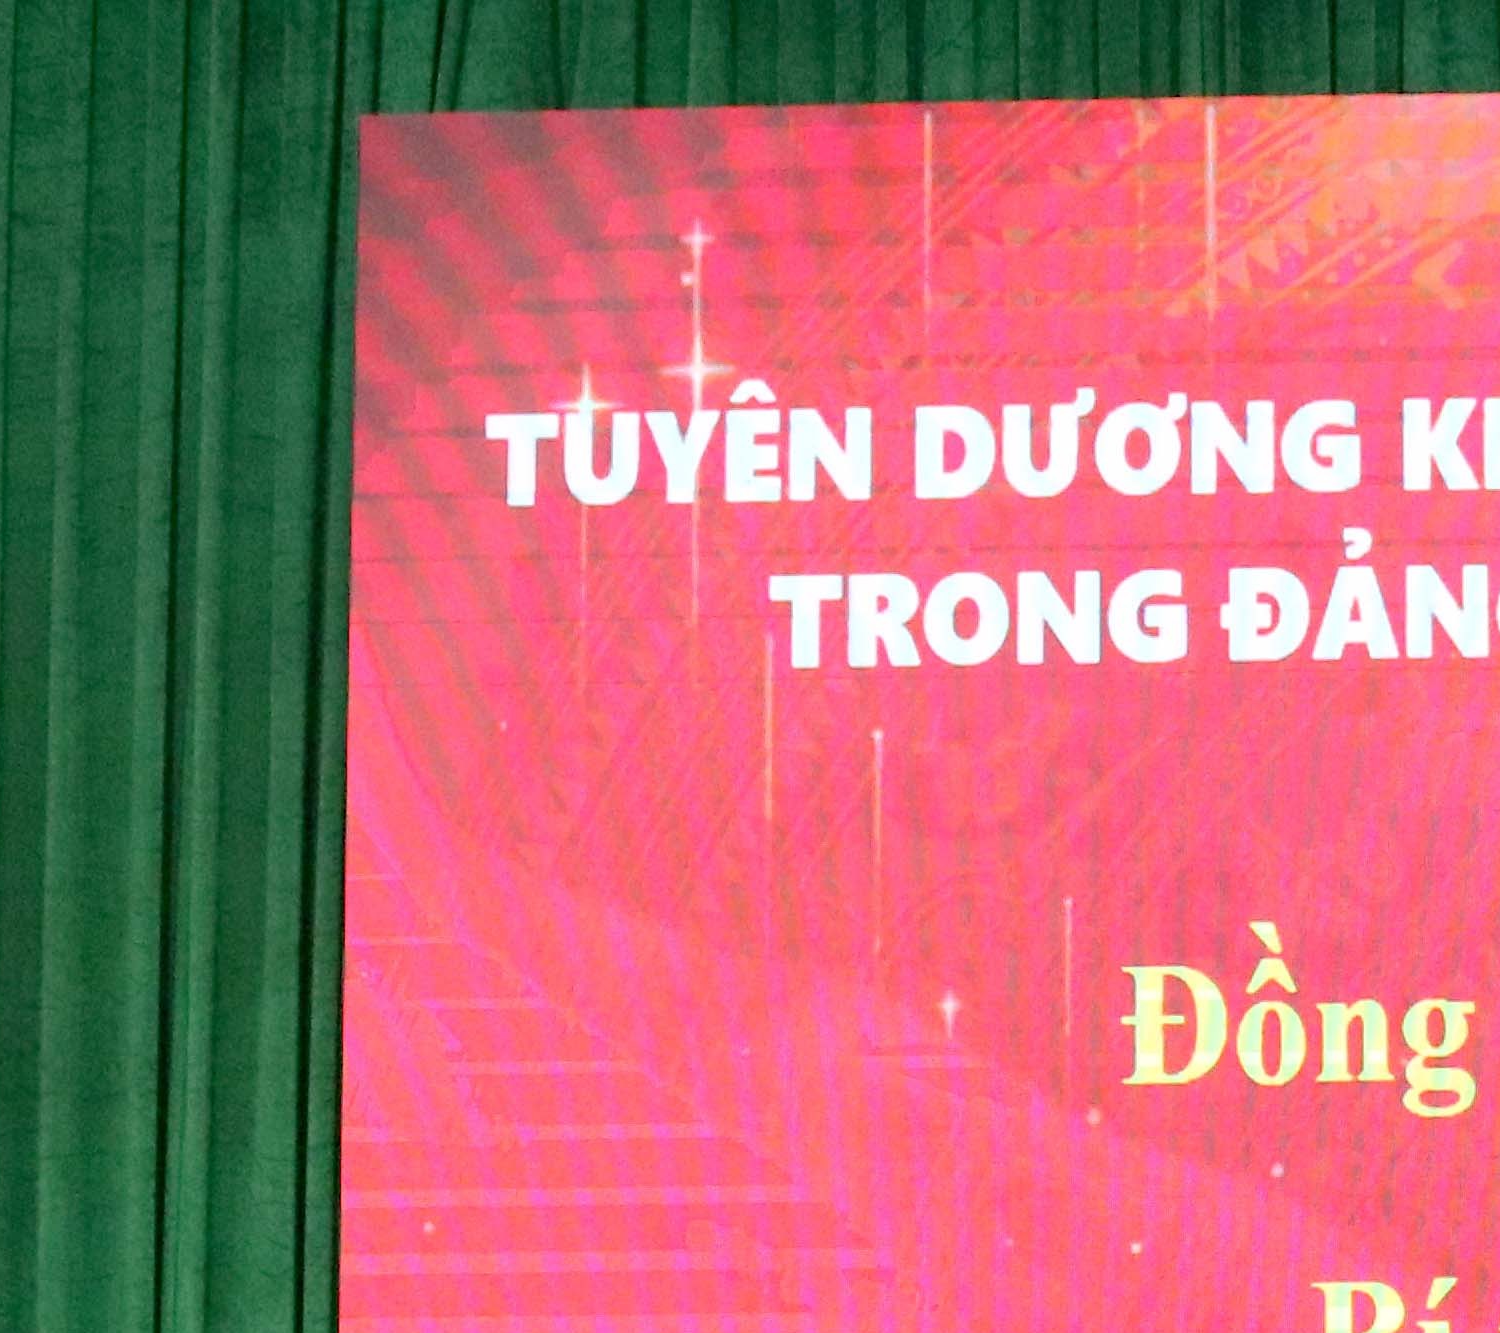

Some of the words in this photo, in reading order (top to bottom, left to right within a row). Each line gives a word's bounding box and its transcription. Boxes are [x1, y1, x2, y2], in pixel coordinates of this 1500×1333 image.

[486, 379, 871, 506] TUYÊN
[916, 388, 1360, 498] DƯƠNG
[769, 570, 1187, 668] TRONG
[1122, 922, 1475, 1116] Đồng
